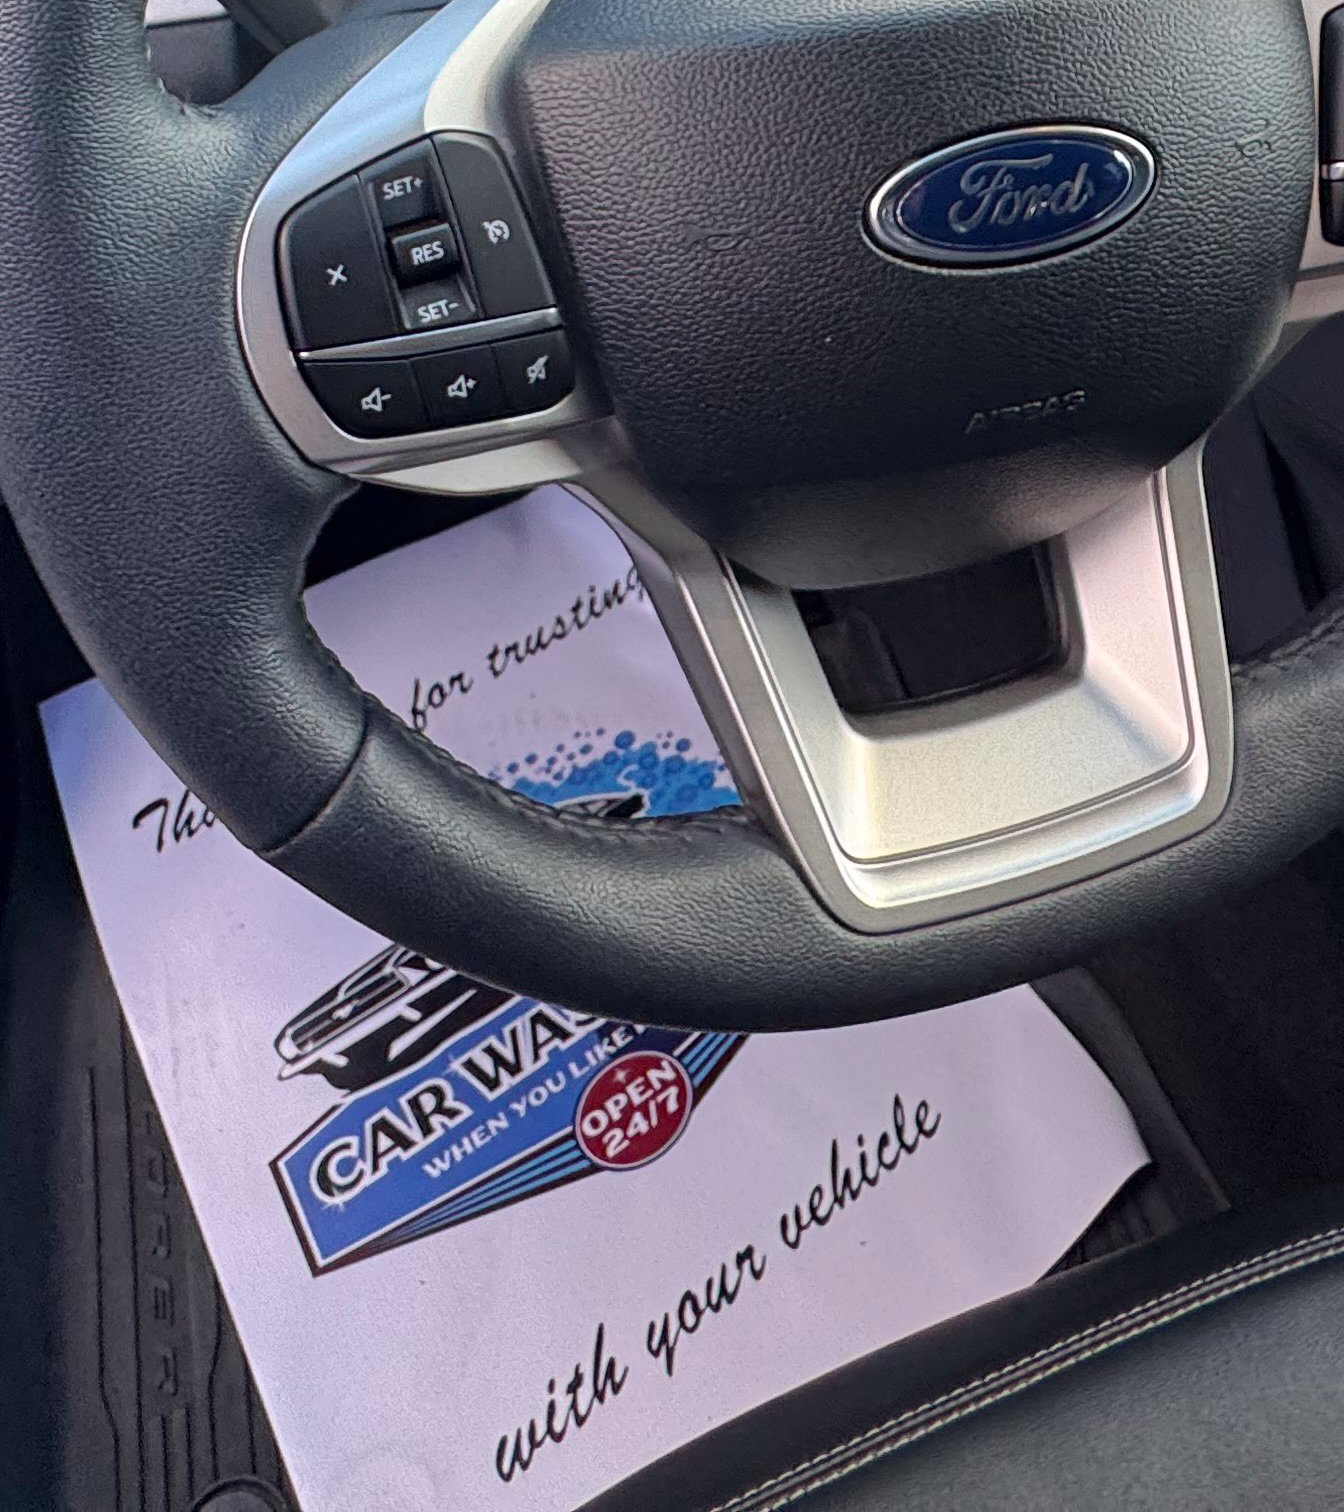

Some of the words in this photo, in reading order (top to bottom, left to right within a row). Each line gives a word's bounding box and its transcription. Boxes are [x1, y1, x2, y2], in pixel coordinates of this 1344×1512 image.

[383, 176, 424, 201] SET+
[948, 152, 1094, 234] Ford
[411, 241, 445, 266] RES
[417, 299, 459, 324] SET-
[411, 671, 475, 733] for
[311, 1080, 470, 1202] CAR
[459, 1002, 601, 1098] WA
[422, 1110, 510, 1179] WHEN
[513, 1071, 567, 1118] YOU
[568, 1024, 635, 1080] LIKE
[582, 1059, 677, 1138] OPEN
[602, 1085, 680, 1159] 24/7
[495, 1322, 629, 1483] with
[647, 1244, 767, 1377] your
[779, 1093, 942, 1250] vehicle
